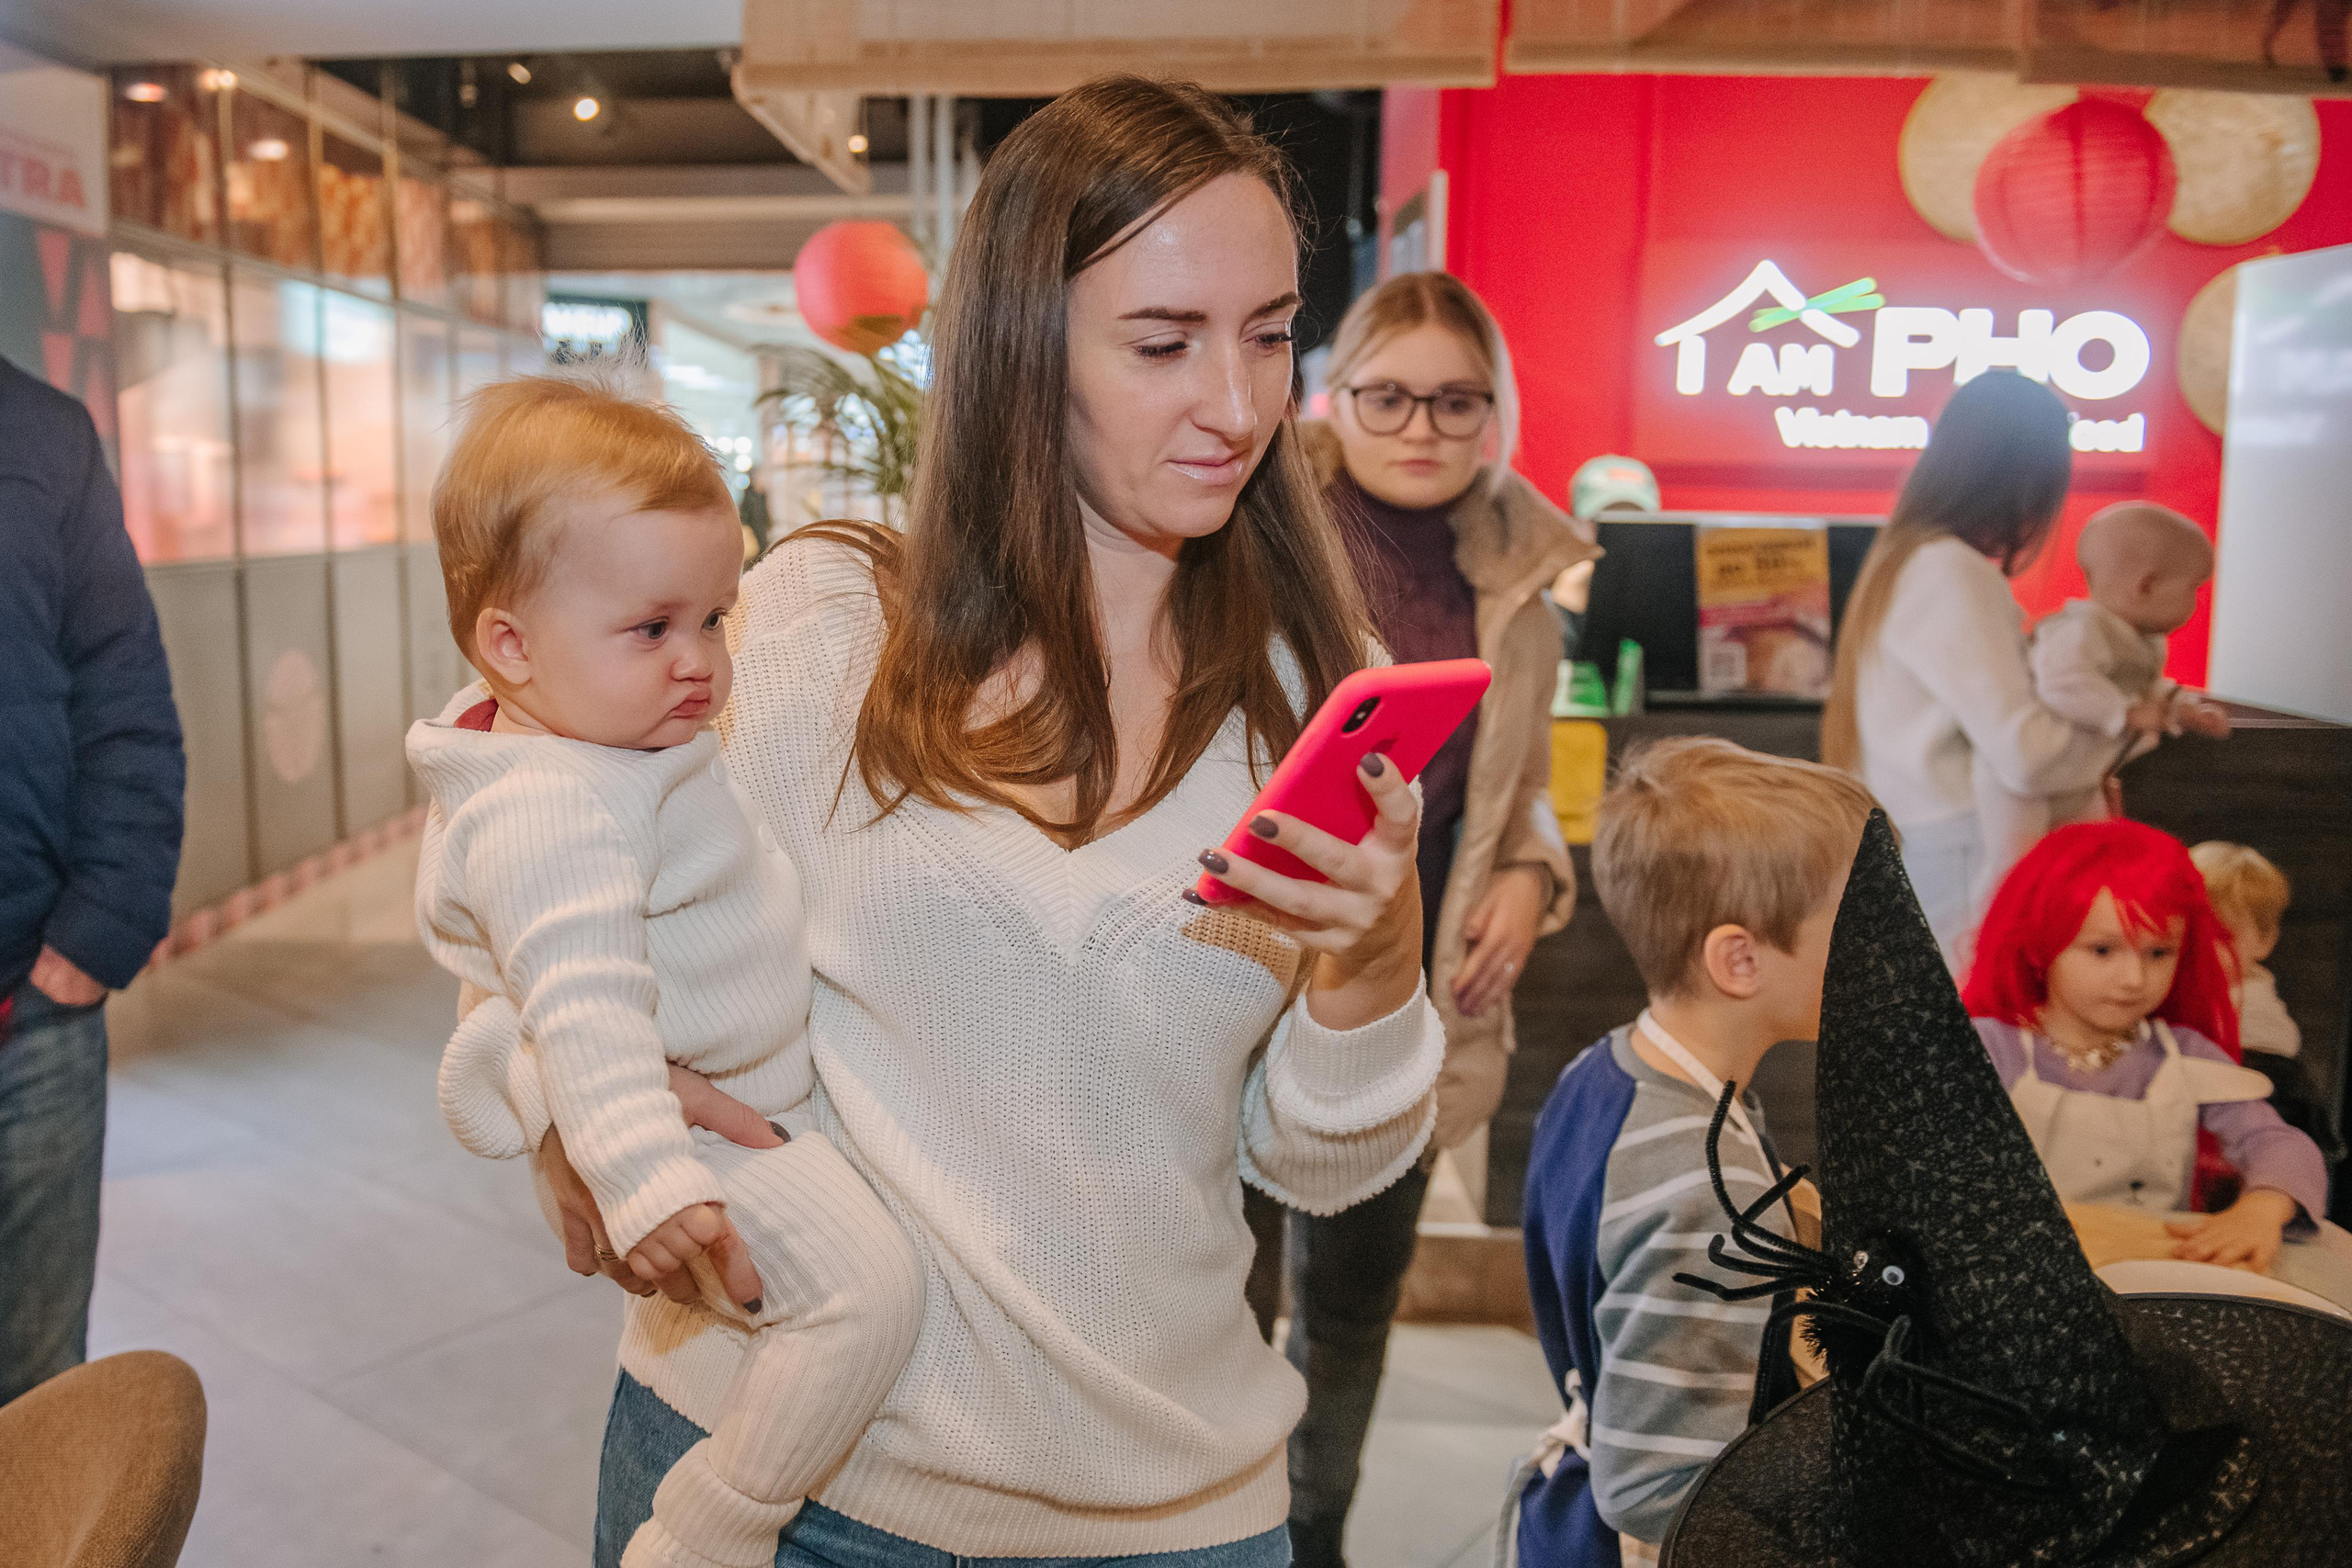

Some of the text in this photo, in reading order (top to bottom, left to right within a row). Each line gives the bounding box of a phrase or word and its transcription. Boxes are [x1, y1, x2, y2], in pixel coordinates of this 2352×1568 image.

[1676, 307, 2151, 400] I AM PHO
[2068, 412, 2145, 452] ood
